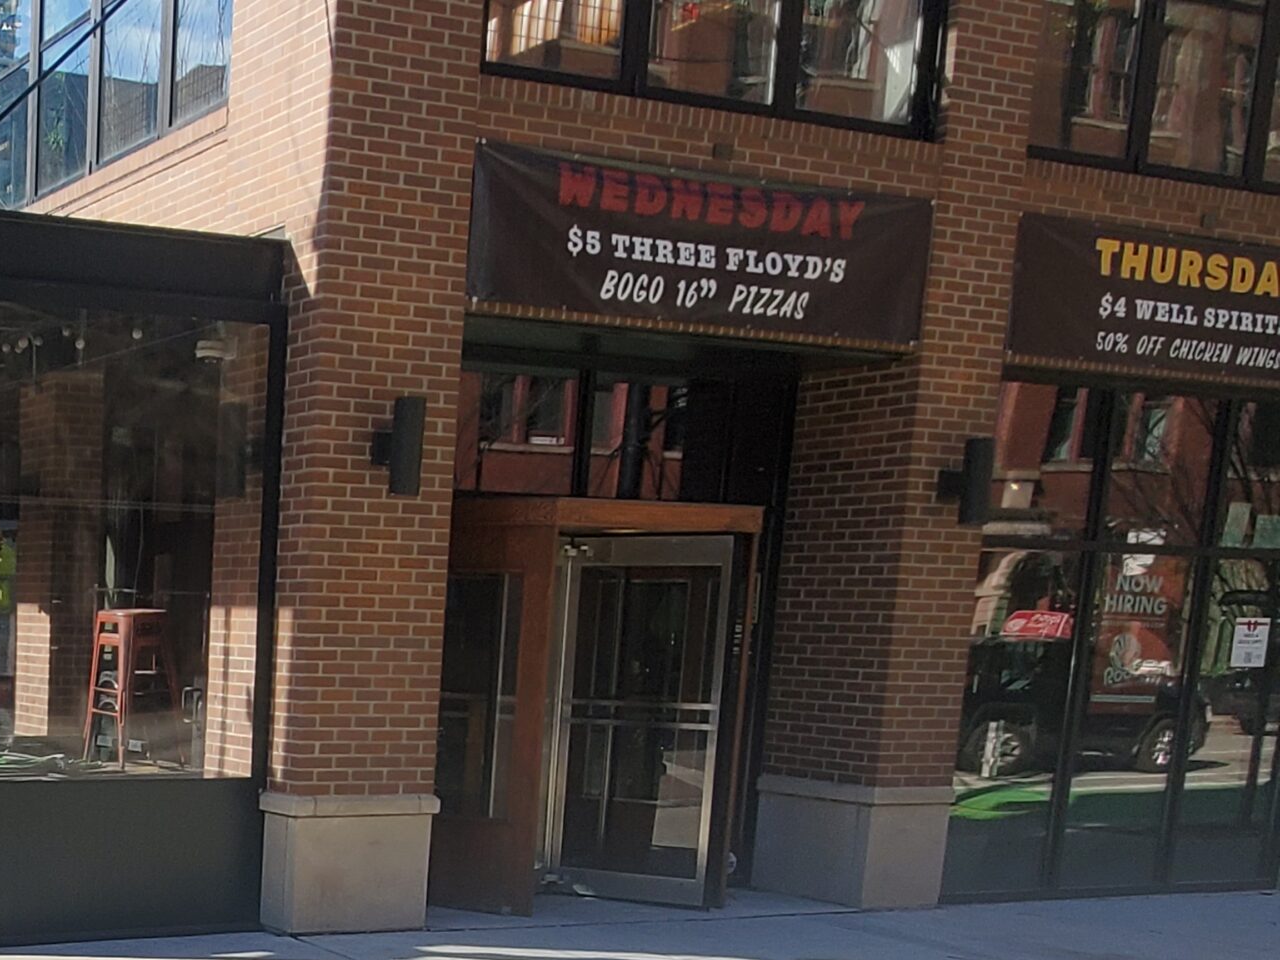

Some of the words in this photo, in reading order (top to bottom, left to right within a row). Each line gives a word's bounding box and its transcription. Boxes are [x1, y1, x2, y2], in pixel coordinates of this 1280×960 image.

[558, 162, 866, 240] WEDNESDAY
[567, 223, 601, 257] $5
[611, 232, 717, 269] THREE
[725, 247, 847, 283] FLOYD'S
[600, 269, 665, 305] BOGO
[728, 283, 810, 320] PIZZAS
[1098, 291, 1128, 320] $4
[1135, 298, 1199, 326] WELL
[1095, 331, 1130, 355] 50%
[1136, 335, 1166, 358] OFF
[1169, 337, 1234, 365] CHICKEN
[1115, 574, 1164, 593] NOW
[1104, 594, 1168, 615] HIRING
